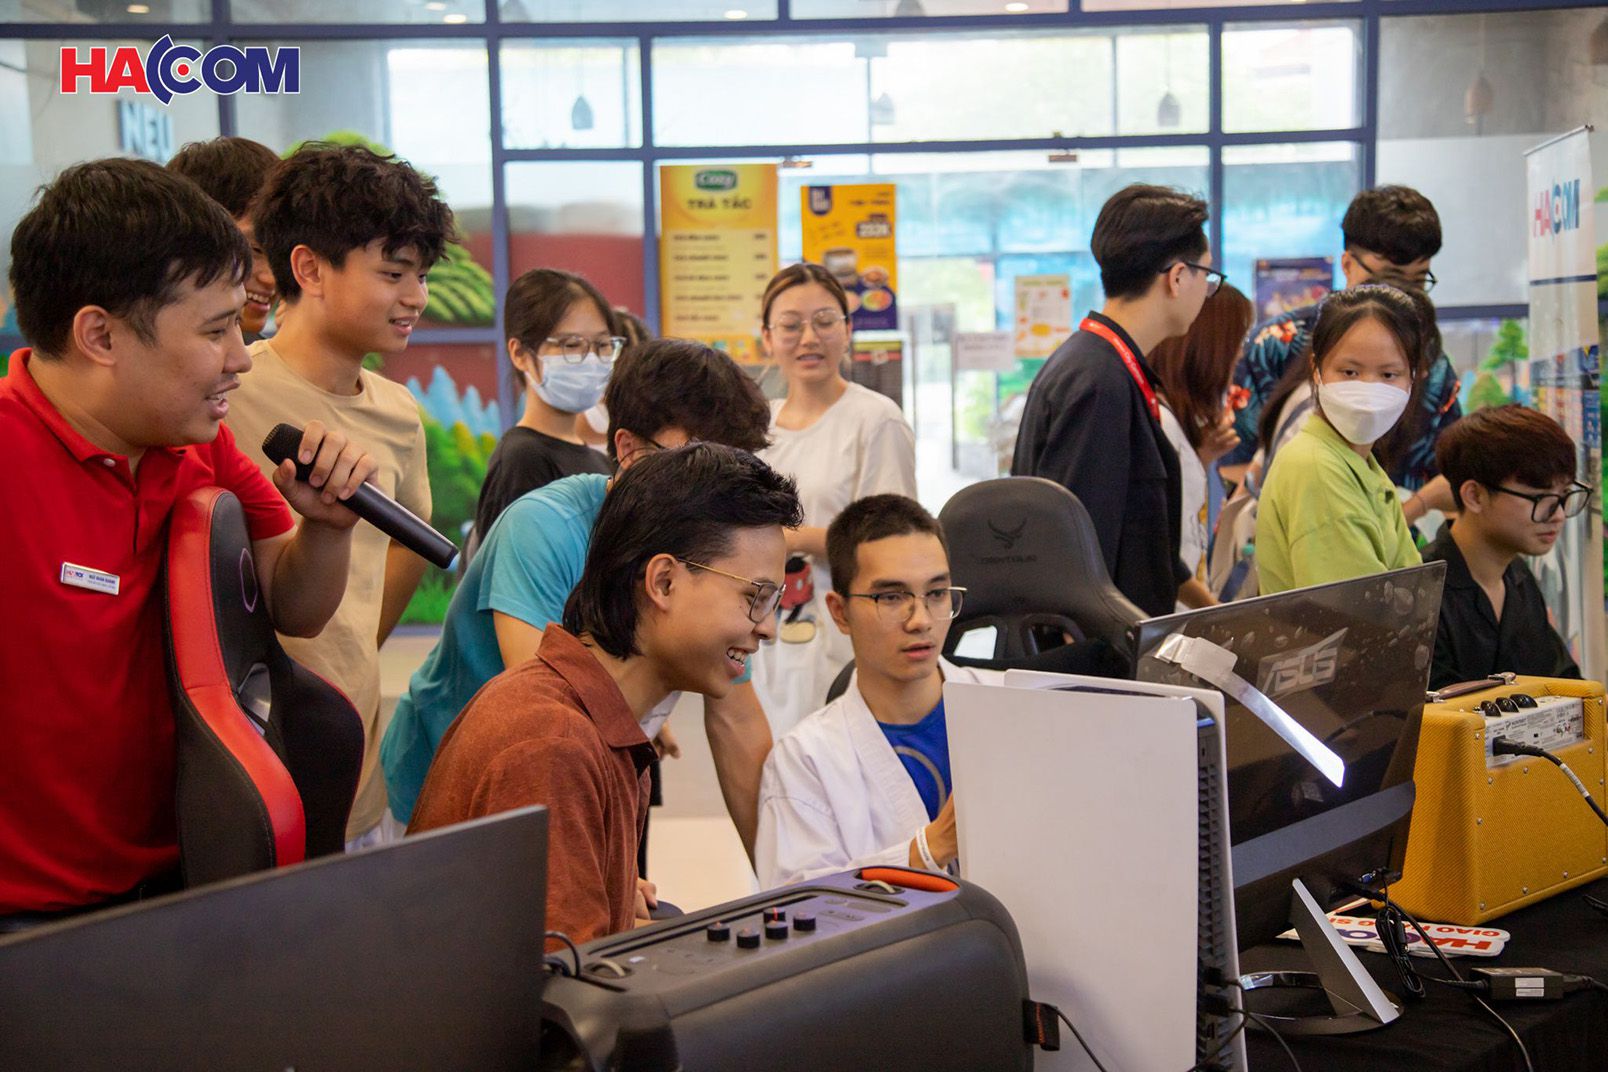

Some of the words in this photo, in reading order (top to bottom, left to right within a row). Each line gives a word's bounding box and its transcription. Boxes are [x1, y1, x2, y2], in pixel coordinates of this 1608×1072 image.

[116, 98, 174, 165] NEU
[1262, 638, 1343, 694] ASUS
[1436, 925, 1501, 937] GIAO
